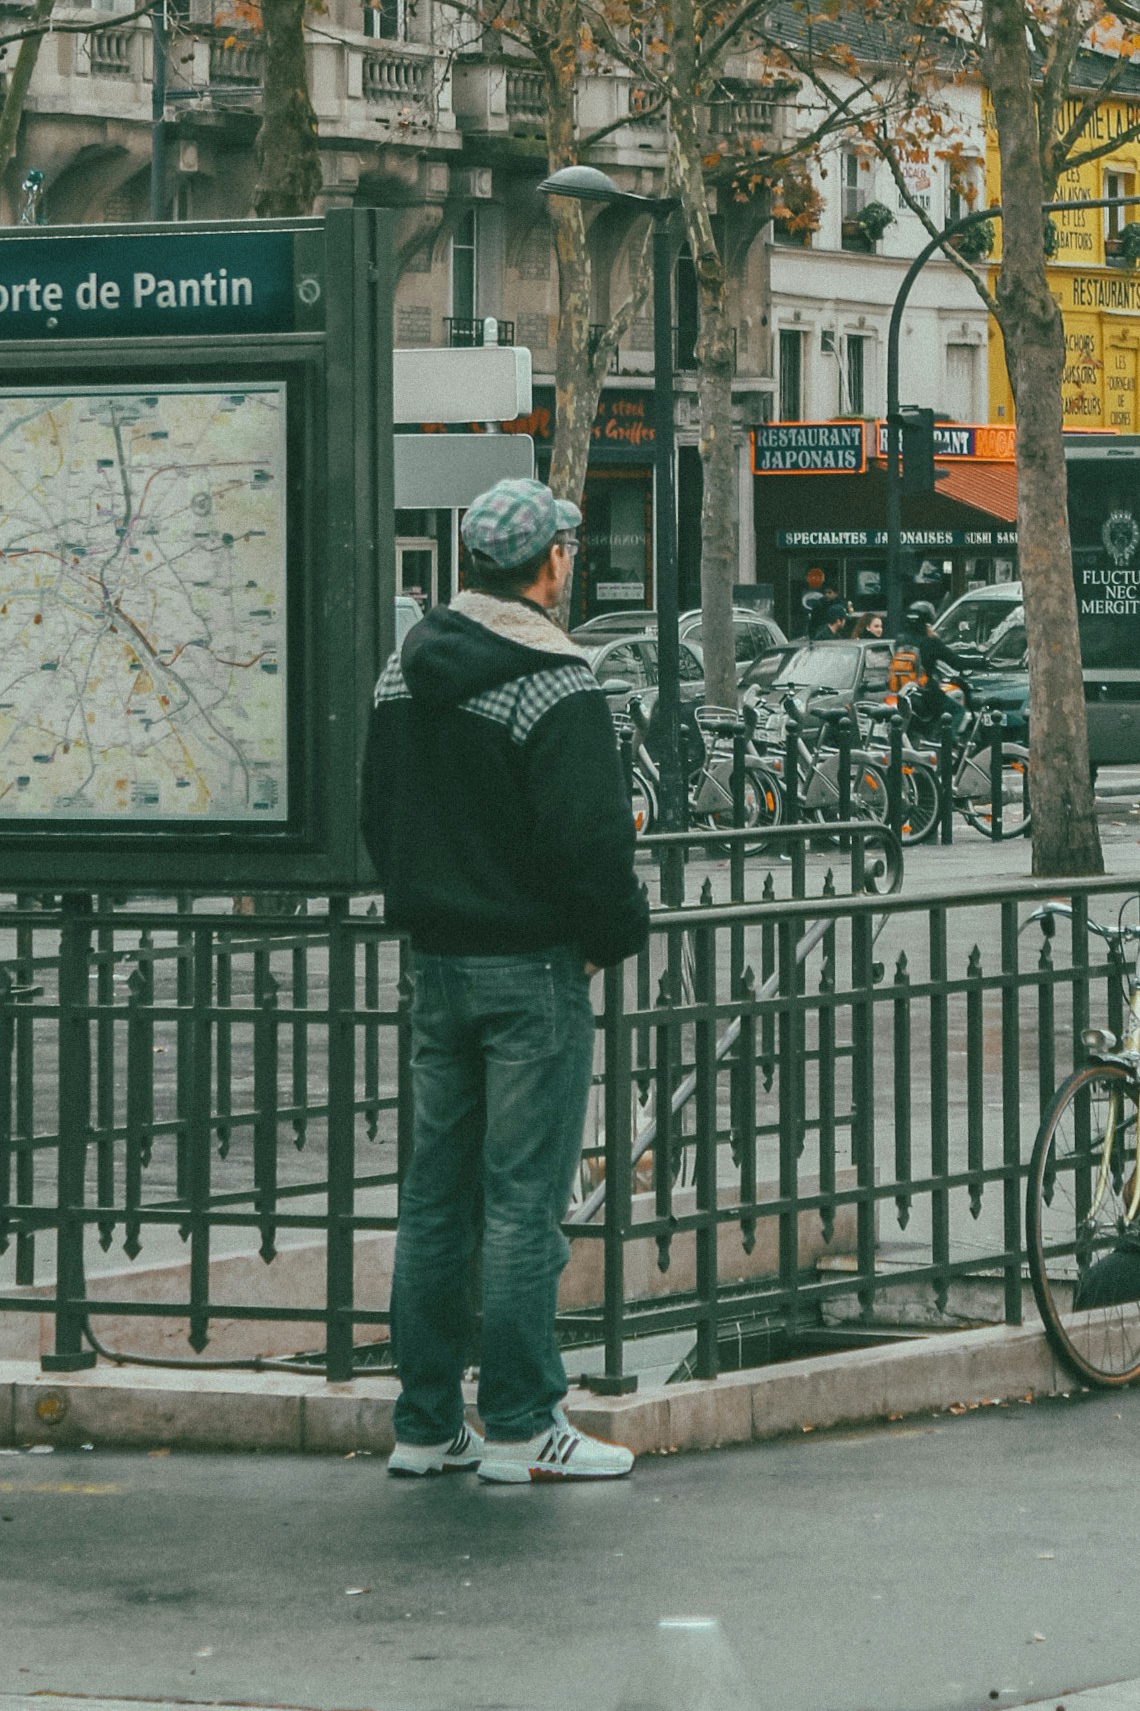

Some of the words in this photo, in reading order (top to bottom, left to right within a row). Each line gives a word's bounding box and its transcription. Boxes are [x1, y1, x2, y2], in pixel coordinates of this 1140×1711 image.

[76, 273, 121, 310] de
[133, 268, 253, 308] Pantin
[757, 426, 862, 448] RESTAURANT
[761, 449, 857, 470] JAPONAIS
[785, 531, 868, 545] SPECIALITES
[874, 531, 954, 545] JAONAISES
[964, 531, 992, 545] SUSHI
[1105, 585, 1138, 600] NEC
